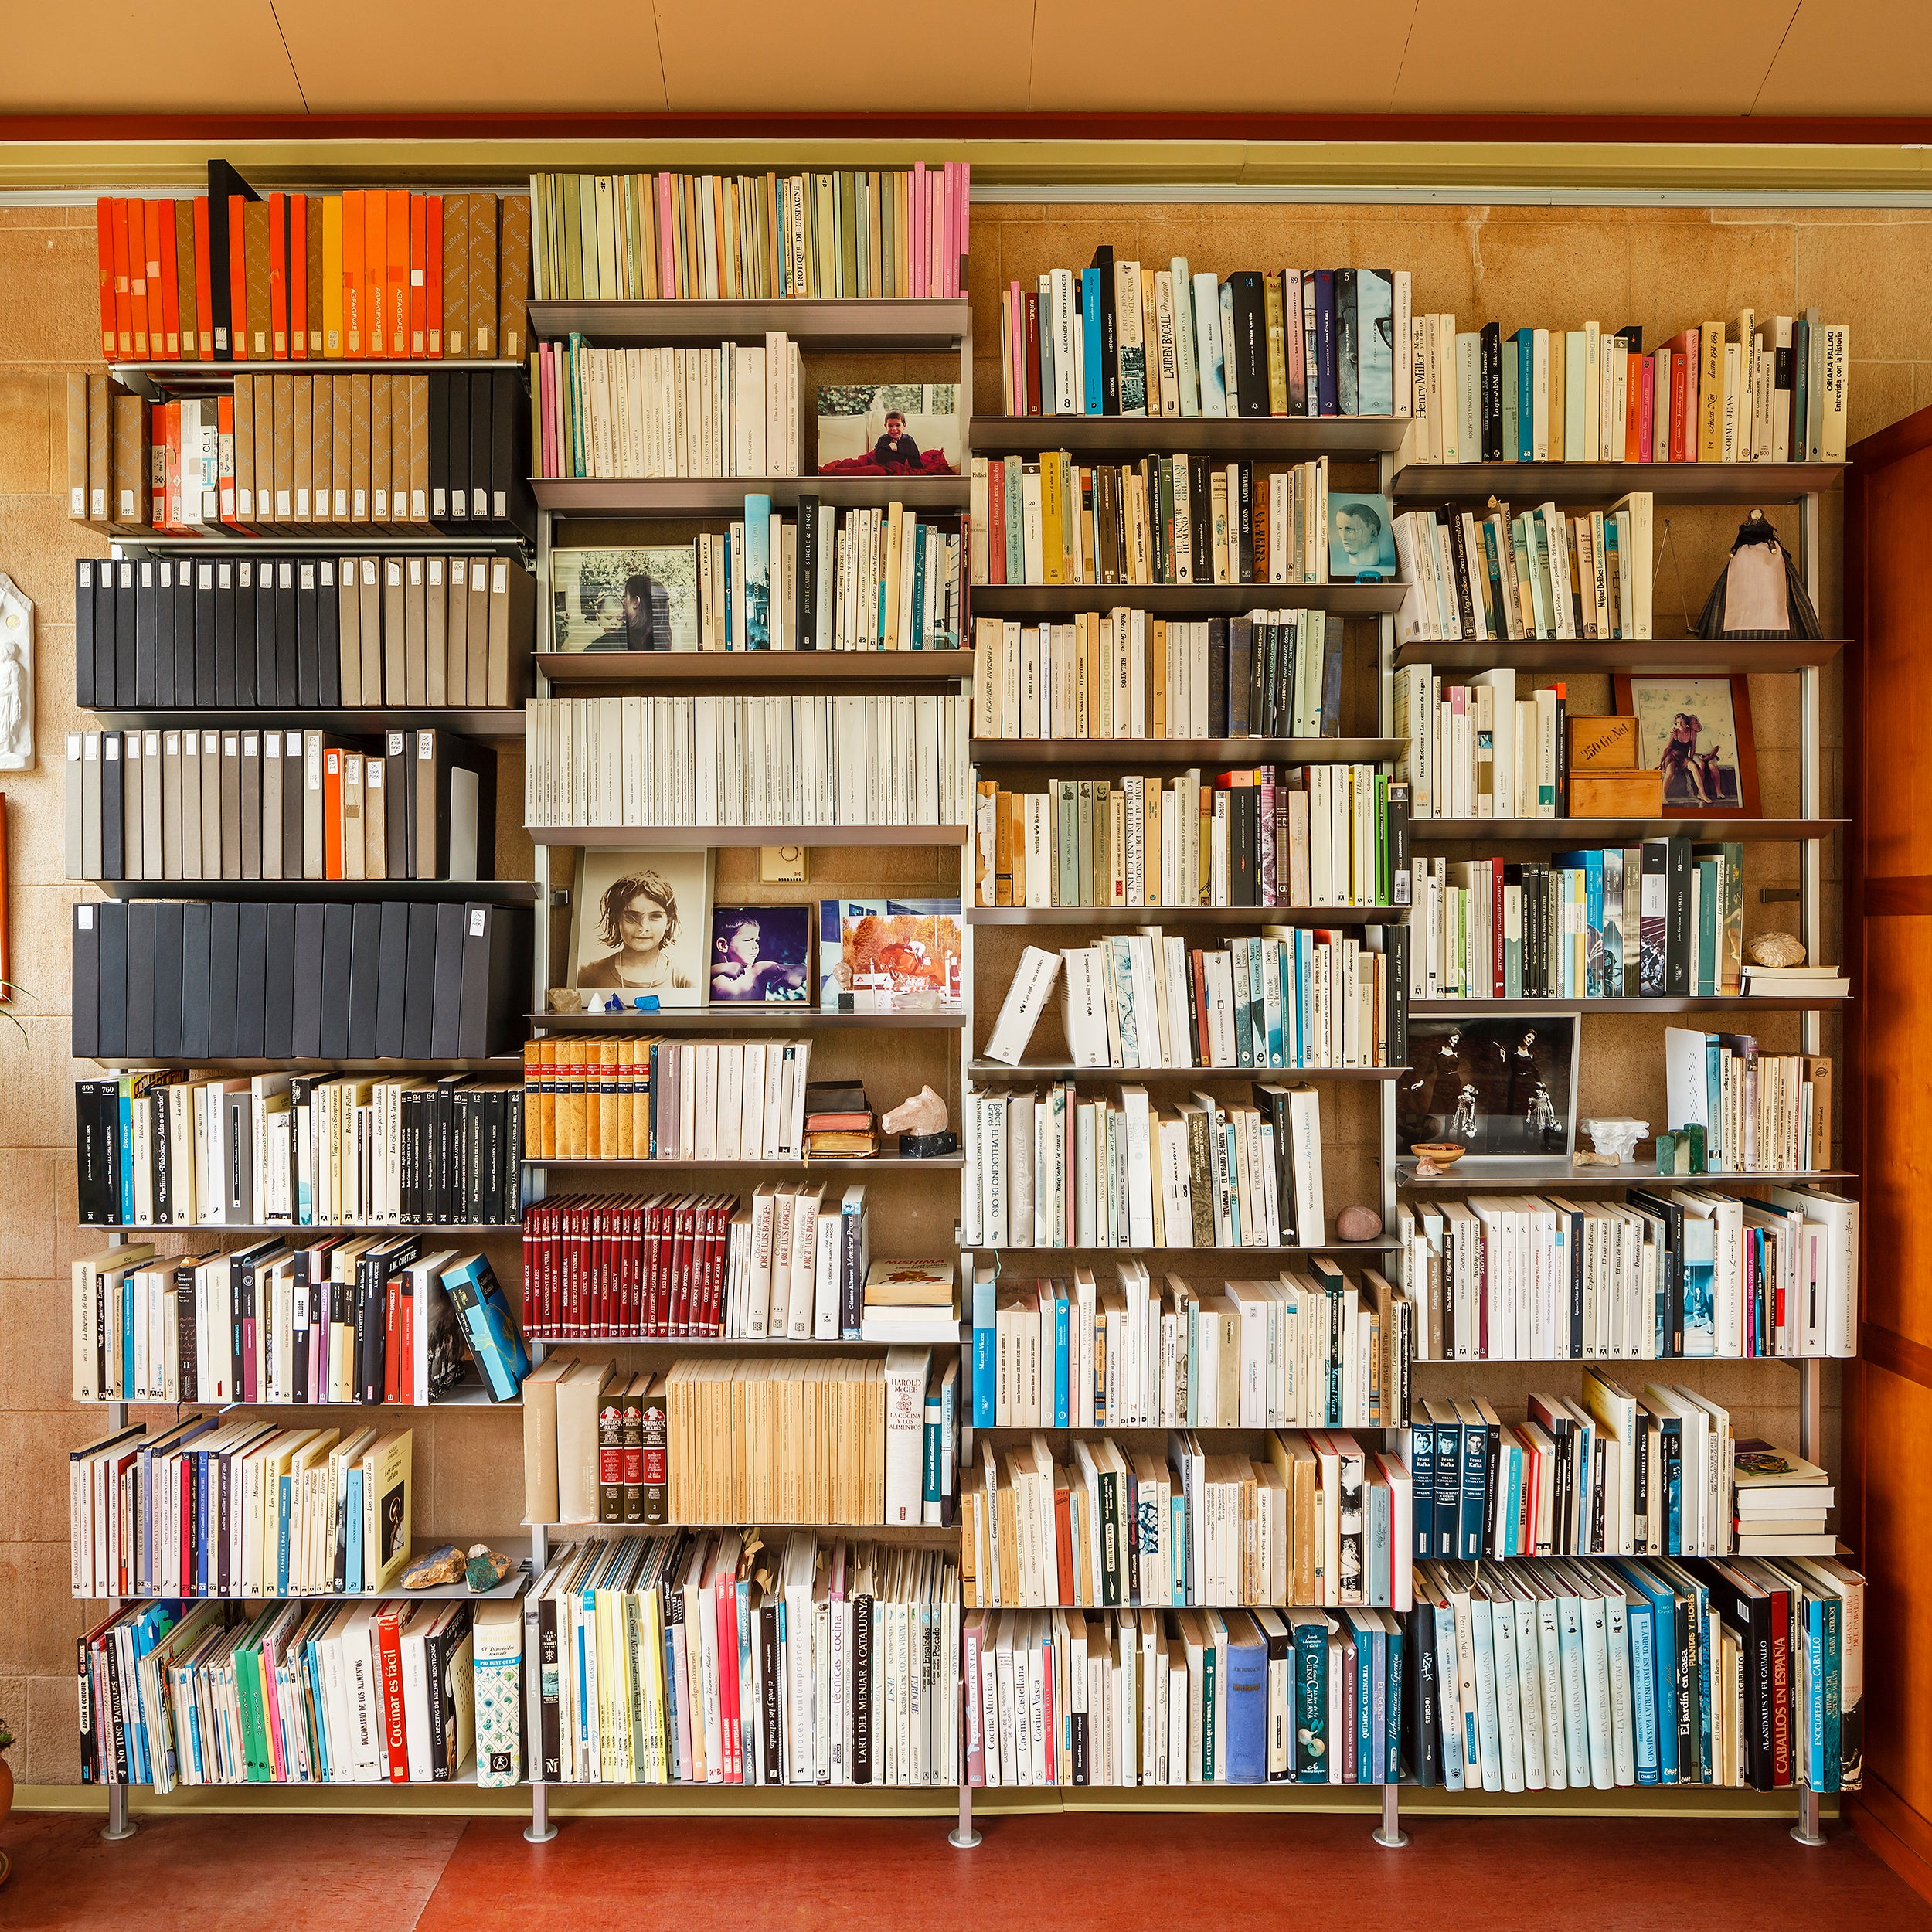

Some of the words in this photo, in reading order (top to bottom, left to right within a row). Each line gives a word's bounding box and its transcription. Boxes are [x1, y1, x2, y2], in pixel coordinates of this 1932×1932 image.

[793, 185, 801, 227] L'ESPAGNE
[794, 230, 802, 242] DE
[794, 247, 804, 287] ÉROTIQUE
[1159, 314, 1172, 345] BACALL
[1825, 331, 1834, 359] FALLACI
[1162, 346, 1175, 379] LAUREN
[1414, 352, 1426, 385] Miller
[1415, 386, 1429, 420] Henry
[1834, 379, 1842, 412] Entrevista
[1726, 422, 1734, 453] NORMA
[1010, 473, 1019, 492] Virgilio
[1453, 515, 1462, 532] Mario
[804, 588, 811, 597] LE
[1460, 575, 1469, 595] Delibes
[1462, 596, 1471, 614] Miguel
[986, 715, 992, 723] EL
[1136, 805, 1142, 816] AL
[1136, 835, 1142, 847] DE
[1136, 849, 1142, 861] LA
[1717, 860, 1726, 878] ciegos
[1716, 879, 1725, 904] girasoles
[158, 1171, 167, 1202] Vladimir
[760, 1205, 770, 1233] BORGES
[760, 1233, 770, 1250] LUIS
[760, 1250, 770, 1269] JORGE
[832, 1615, 842, 1651] cocina
[857, 1597, 868, 1656] CATALUNYA
[381, 1648, 397, 1677] fácil
[858, 1657, 867, 1666] A
[1679, 1648, 1689, 1674] casa
[1771, 1636, 1786, 1686] ESPAÑA
[1812, 1637, 1821, 1676] CABALLO
[355, 1659, 366, 1689] ALIMENTOS
[387, 1679, 399, 1693] es
[832, 1659, 842, 1705] técnicas
[1361, 1665, 1369, 1705] CULINARIA
[1482, 1651, 1492, 1694] CATALANA
[1681, 1675, 1689, 1689] en
[356, 1692, 366, 1702] LOS
[858, 1669, 868, 1711] MENJAR
[984, 1672, 994, 1715] Murciana
[1015, 1665, 1026, 1716] Castellana
[1032, 1679, 1042, 1706] Vasca
[1776, 1689, 1786, 1704] EN
[387, 1696, 403, 1748] Cocinar
[1359, 1706, 1369, 1738] QUÍMICA
[1485, 1696, 1493, 1723] CUINA
[1679, 1691, 1692, 1723] jardín
[358, 1713, 369, 1746] DICCIONARIO
[858, 1713, 868, 1733] DEL
[985, 1718, 995, 1750] Cocina
[1018, 1718, 1027, 1752] Cocina
[1032, 1709, 1042, 1742] Cocina
[1680, 1725, 1690, 1736] El
[1761, 1701, 1770, 1751] AL-ANDALUS
[858, 1735, 868, 1764] L'ART
[1774, 1706, 1787, 1774] CABALLOS
